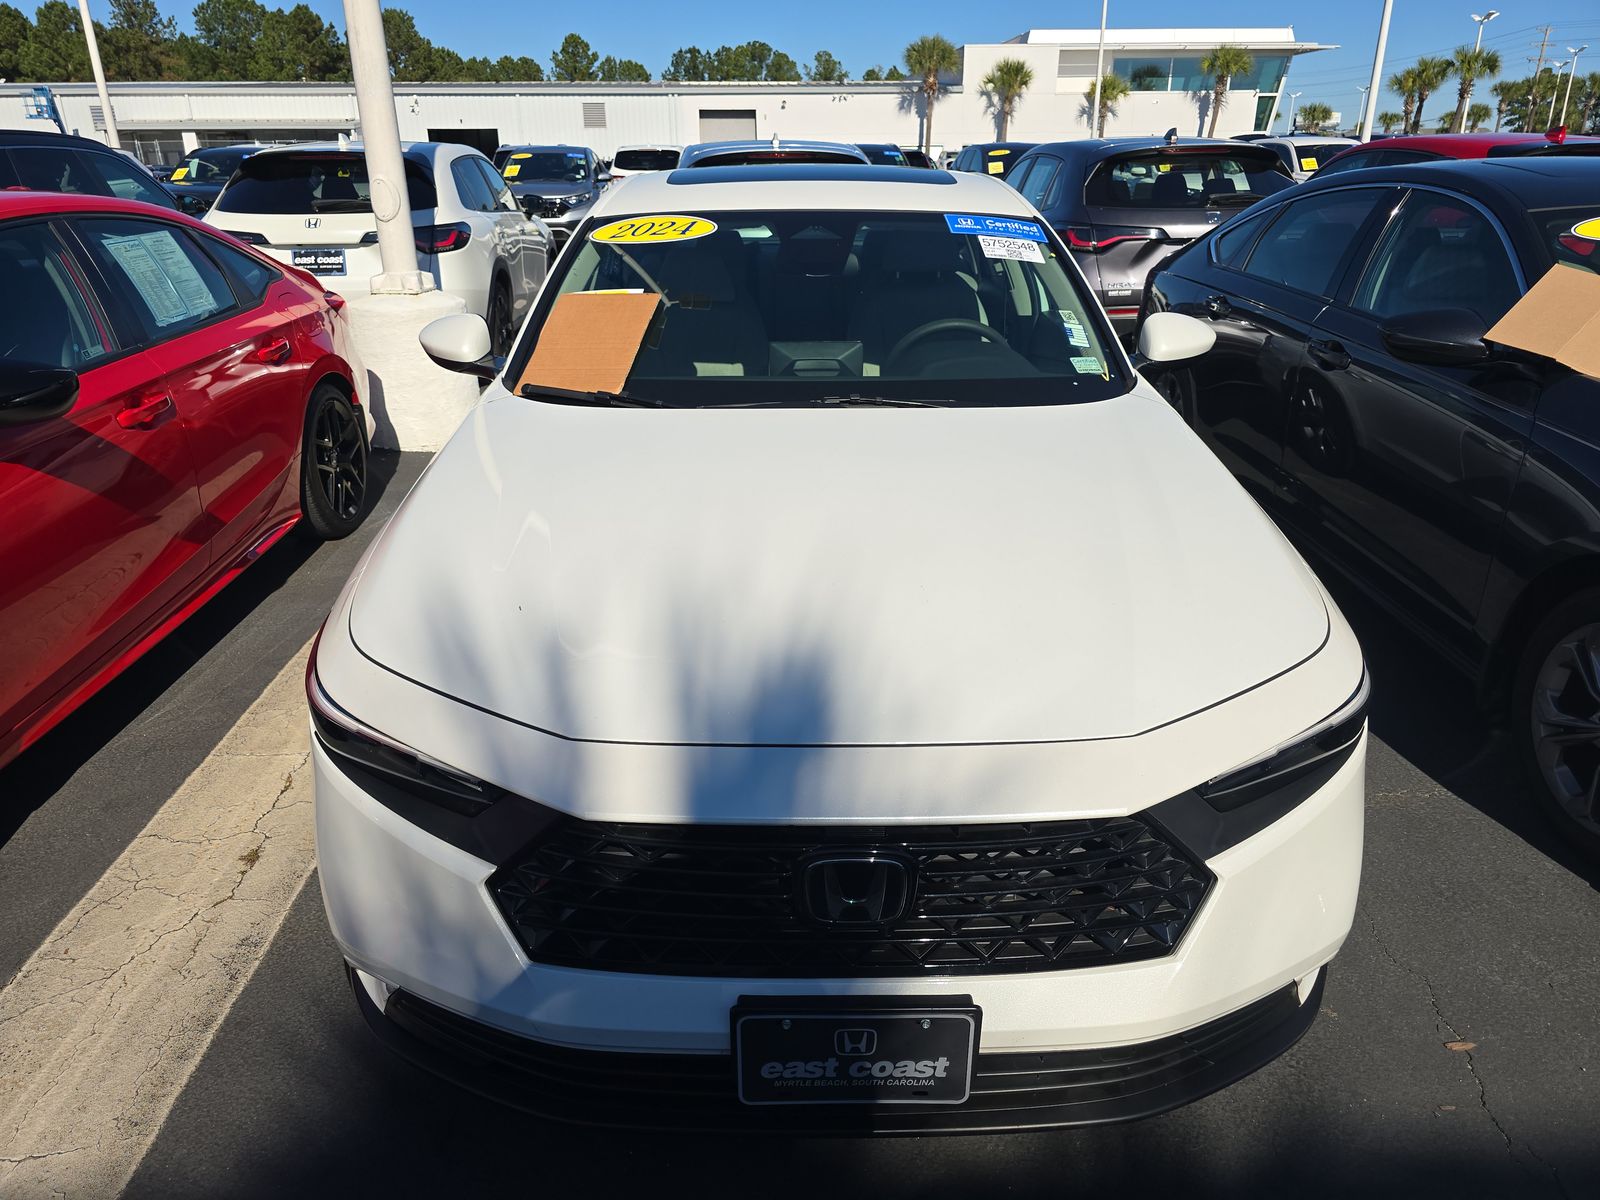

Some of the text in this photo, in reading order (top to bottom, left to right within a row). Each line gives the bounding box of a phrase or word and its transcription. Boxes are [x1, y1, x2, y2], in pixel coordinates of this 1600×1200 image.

[608, 220, 698, 239] 2024
[985, 219, 1038, 232] Certified
[988, 226, 1040, 236] Pre-Owned
[982, 238, 1036, 252] 5752548
[294, 255, 344, 264] east coast
[760, 1057, 950, 1079] east coast
[774, 1079, 813, 1087] MYRTLE
[852, 1079, 885, 1087] SOUTH
[886, 1078, 936, 1086] CAROLINA
